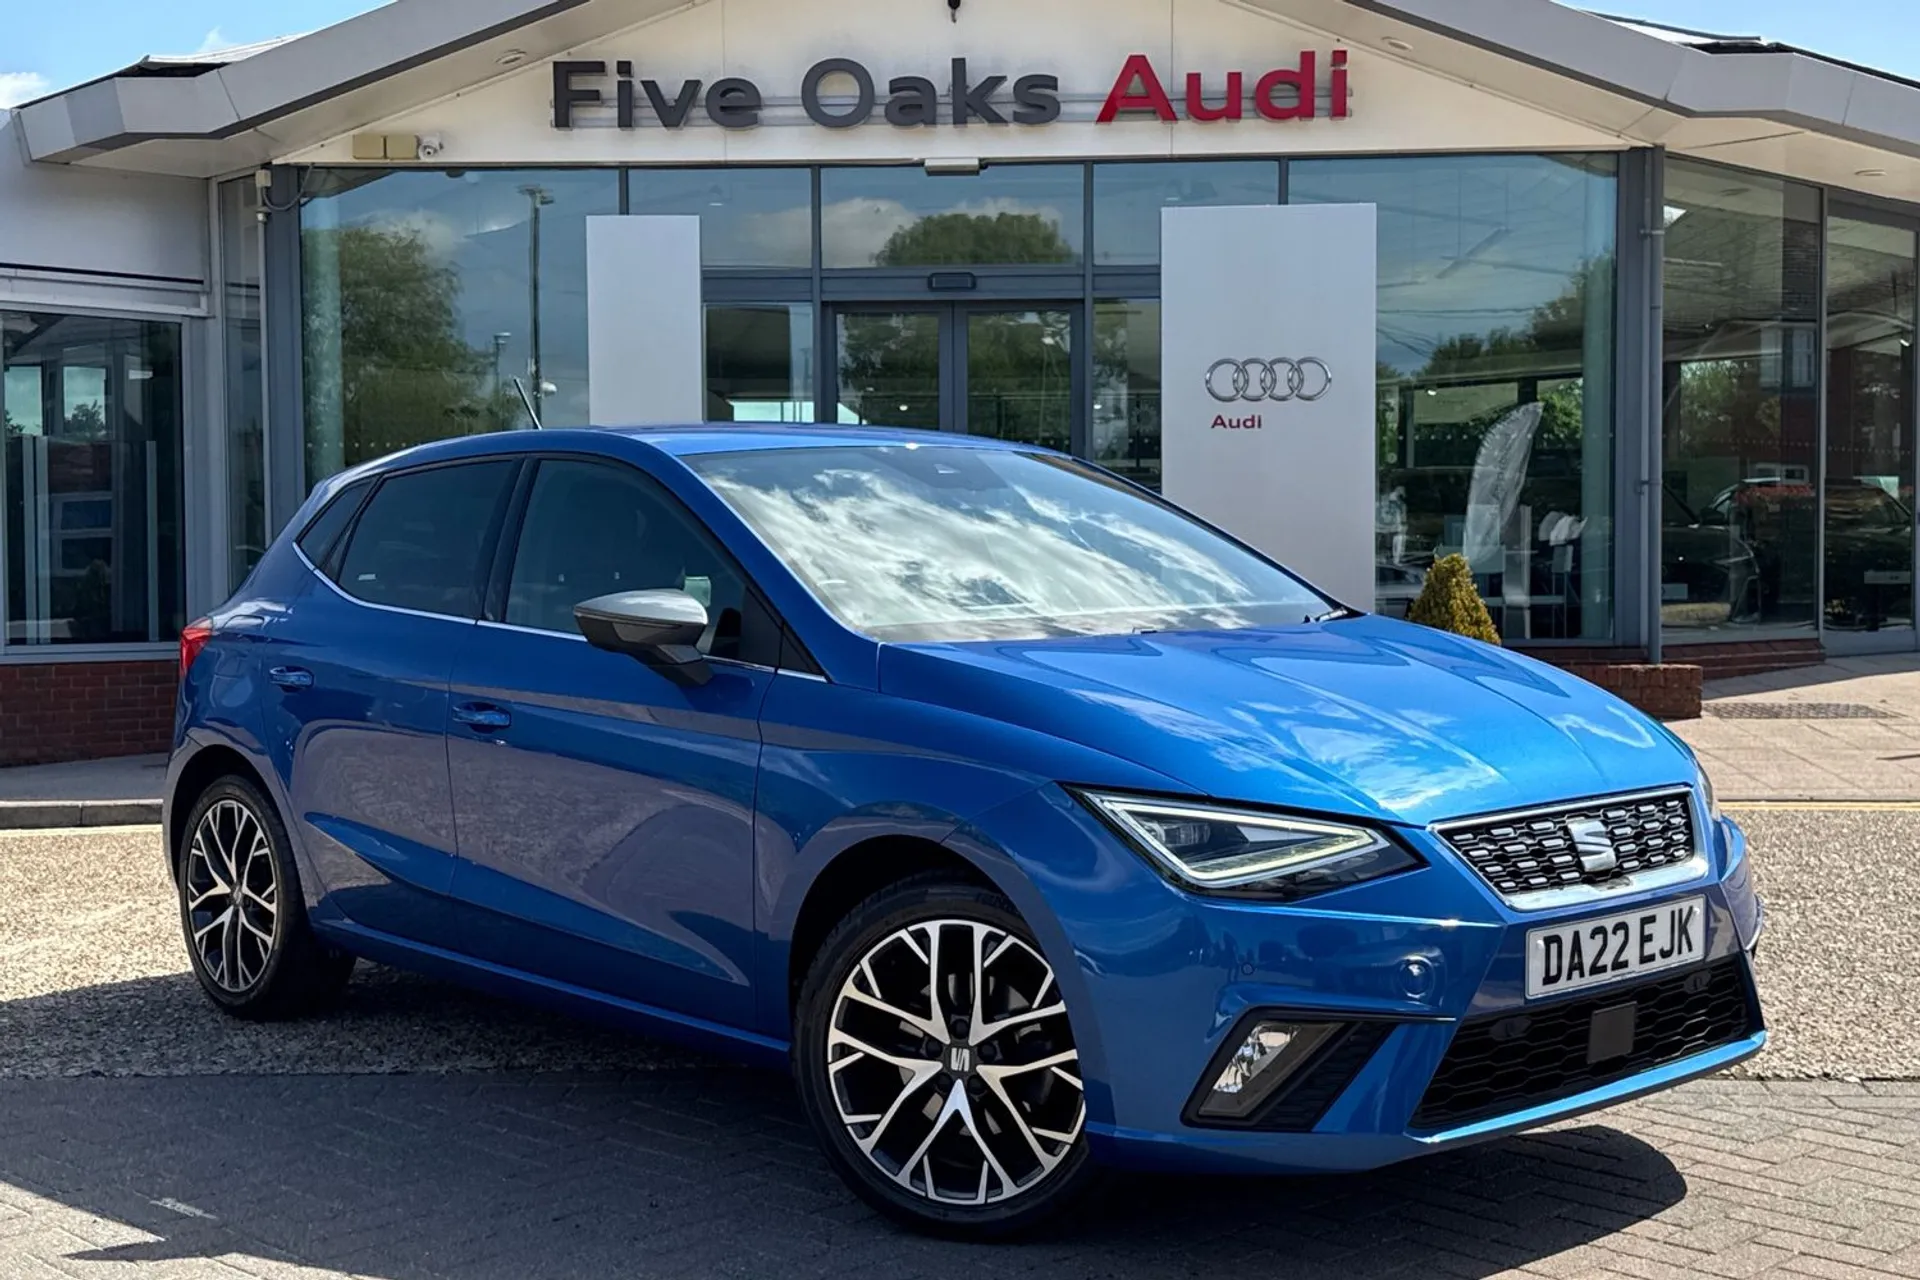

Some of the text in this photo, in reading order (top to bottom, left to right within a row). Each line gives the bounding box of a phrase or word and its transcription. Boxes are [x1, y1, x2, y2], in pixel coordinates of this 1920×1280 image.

[553, 50, 1348, 130] Five Oaks Audi
[1210, 414, 1262, 429] Audi
[1542, 905, 1694, 986] DA22 EJK
